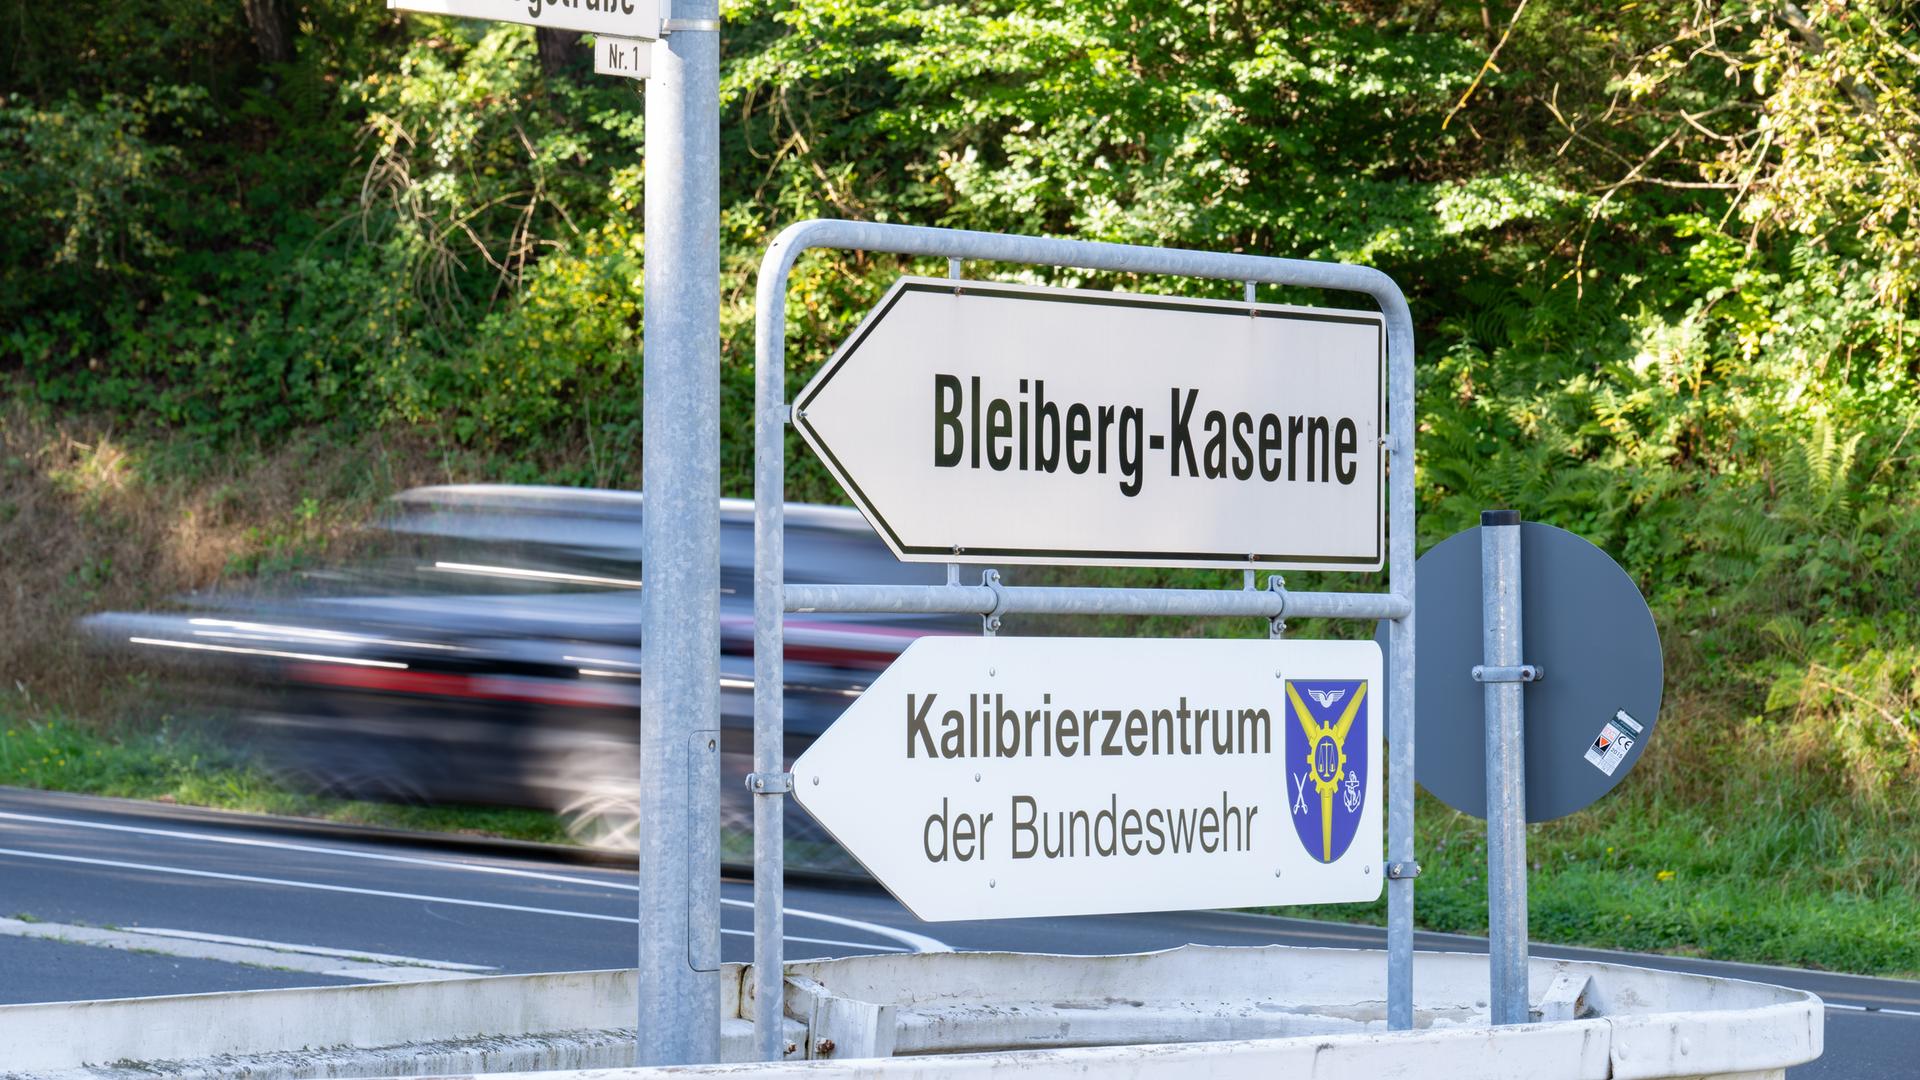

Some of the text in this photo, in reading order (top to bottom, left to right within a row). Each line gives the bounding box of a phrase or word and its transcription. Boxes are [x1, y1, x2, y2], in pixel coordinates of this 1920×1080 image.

[609, 44, 638, 71] Nr. 1
[935, 374, 1357, 497] Bleiberg-Kaserne
[907, 694, 1271, 759] Kalibrierzentrum
[923, 791, 1258, 863] der Bundeswehr
